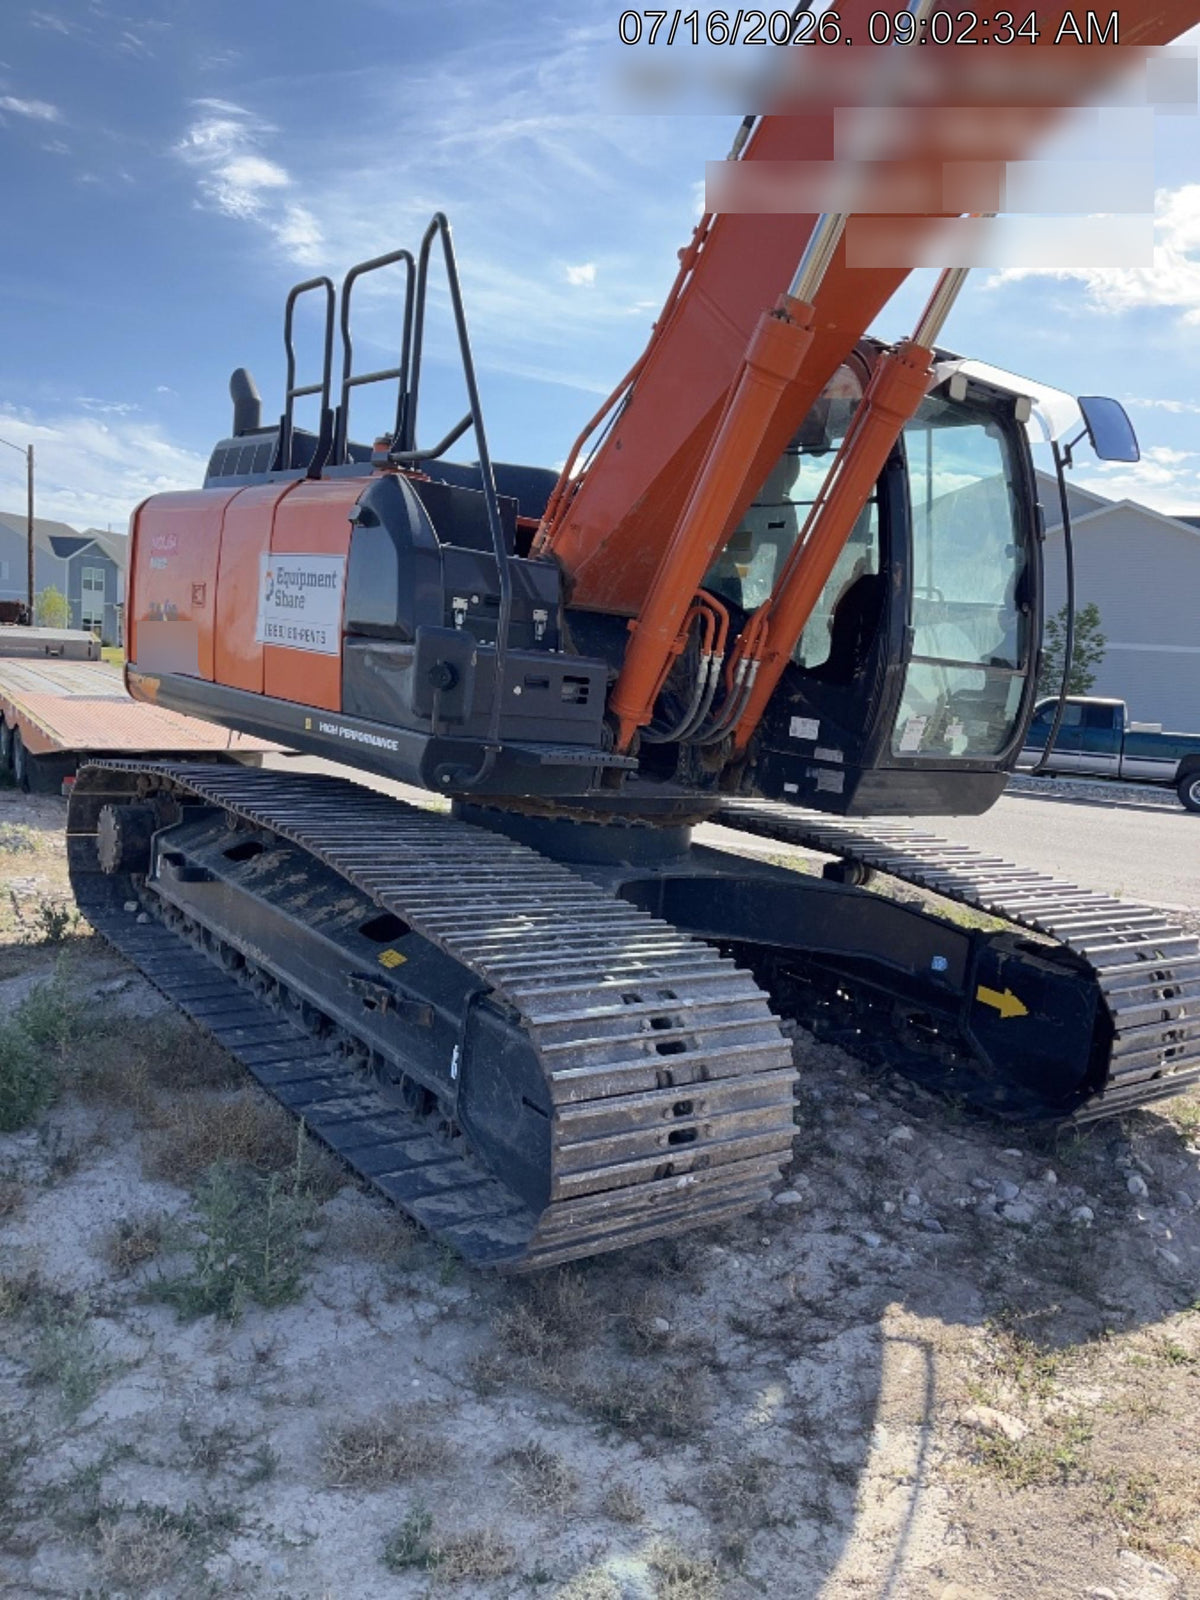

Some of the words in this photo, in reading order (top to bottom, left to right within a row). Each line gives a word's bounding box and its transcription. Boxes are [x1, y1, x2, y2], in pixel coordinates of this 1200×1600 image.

[276, 567, 337, 590] Equipment
[275, 589, 305, 609] Share
[319, 721, 338, 735] HIGH
